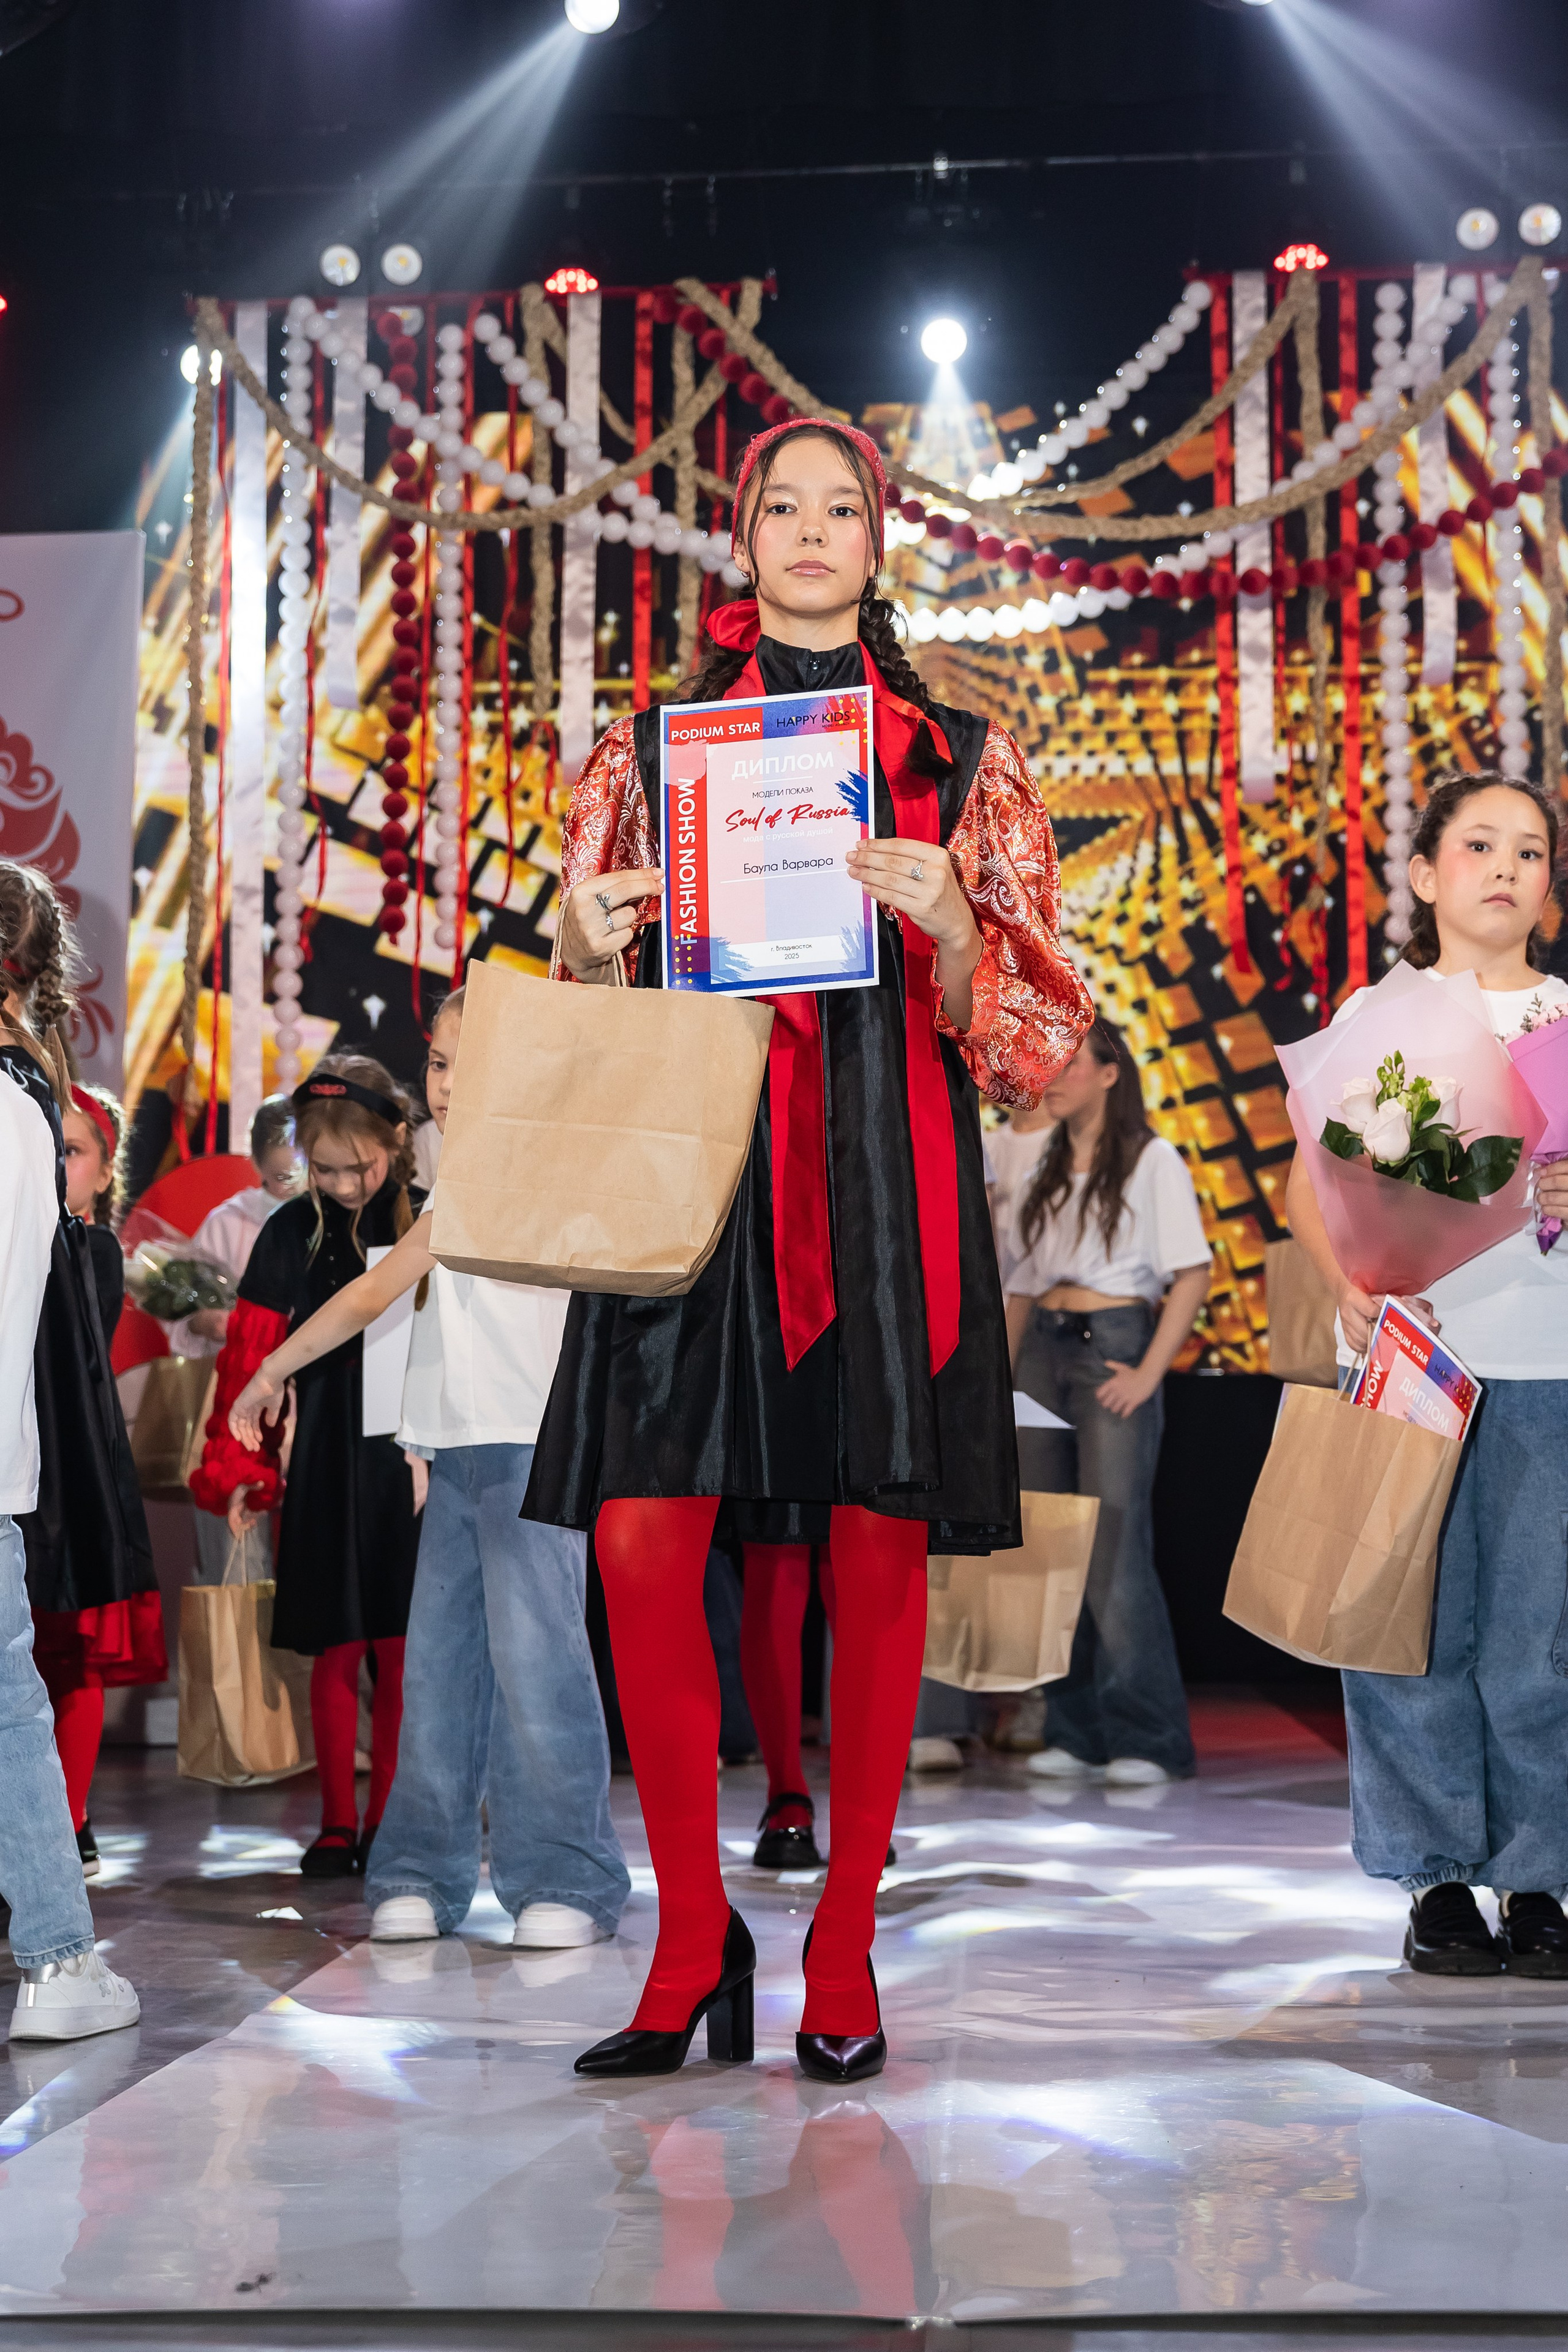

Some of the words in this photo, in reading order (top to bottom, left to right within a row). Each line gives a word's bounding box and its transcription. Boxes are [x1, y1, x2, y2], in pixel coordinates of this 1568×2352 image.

[671, 726, 724, 741] PODIUM
[728, 722, 760, 735] STAR
[777, 714, 818, 728] HAPPY
[822, 711, 850, 723] KIDS
[731, 751, 834, 780] ДИПЛОМ
[752, 790, 784, 799] МОДЕЛИ
[785, 786, 813, 796] ПОКАЗА
[677, 778, 696, 844] SHOW
[725, 807, 766, 832] Soul
[764, 808, 783, 829] of
[787, 804, 850, 825] Russia
[772, 829, 805, 842] русской
[806, 827, 833, 837] душой
[744, 863, 778, 875] Баула
[782, 858, 833, 870] Варвара
[678, 848, 697, 945] FASHION
[1384, 1319, 1412, 1351] PODIUM
[1411, 1344, 1429, 1366] STAR
[1360, 1359, 1384, 1408] HOW
[1399, 1376, 1450, 1433] ДИПЛОМ
